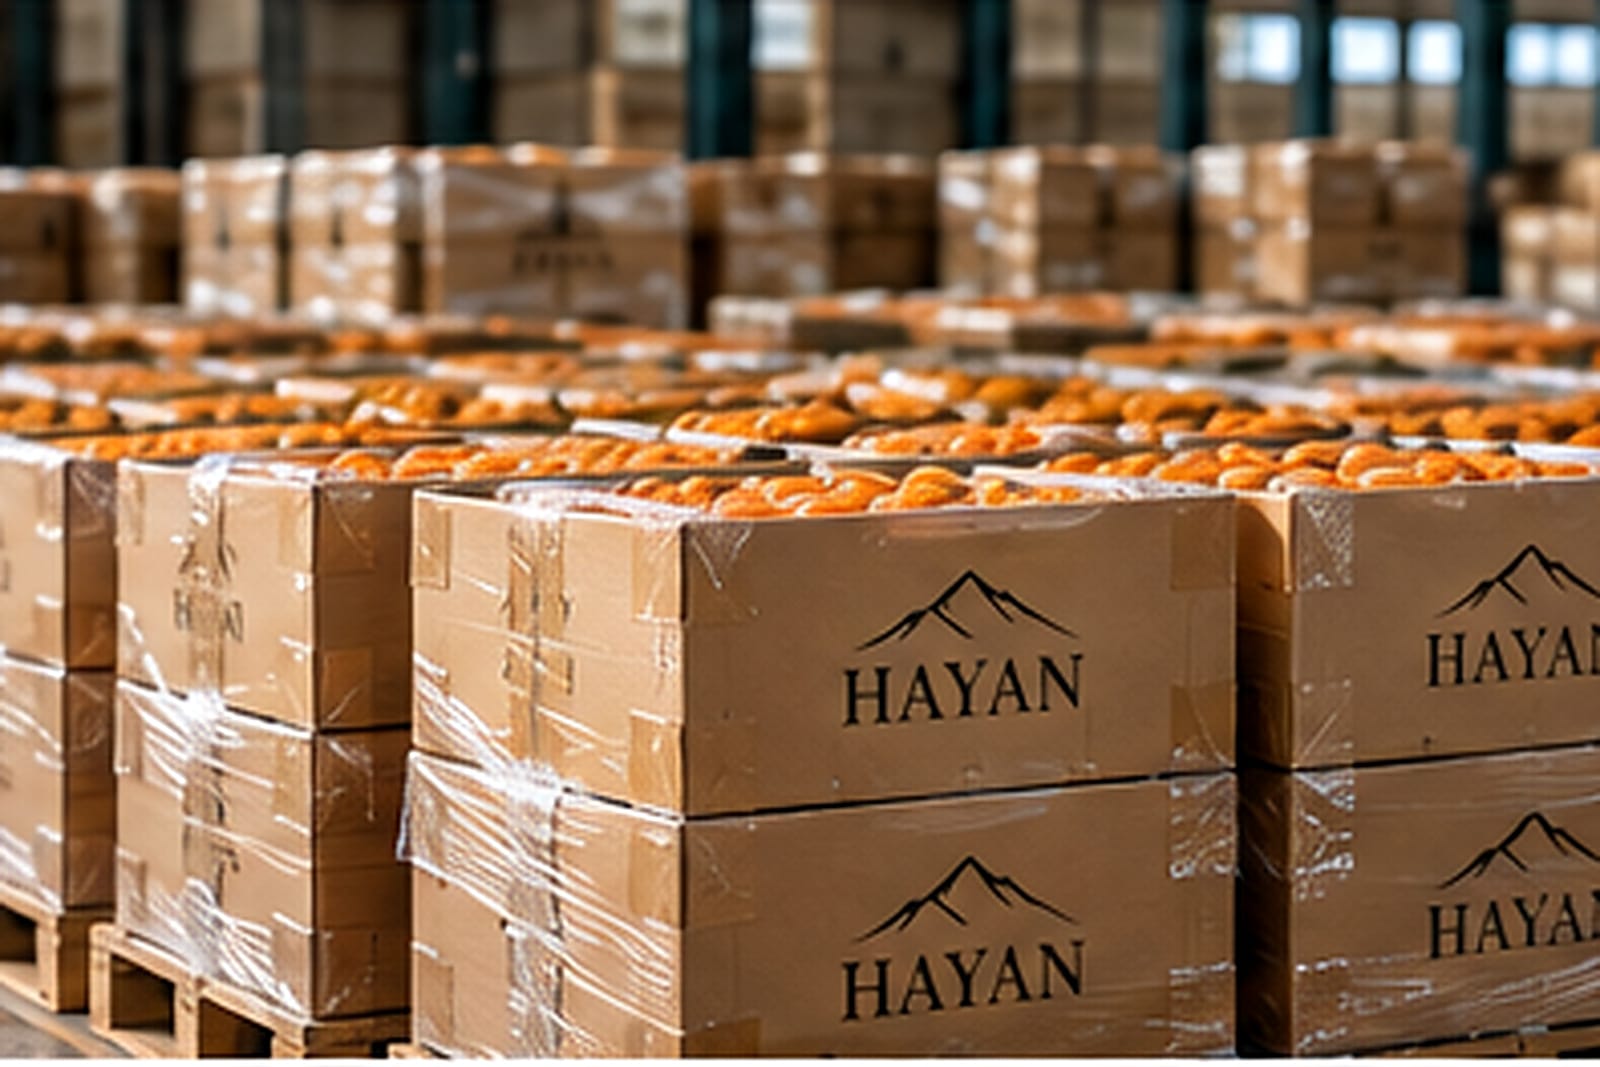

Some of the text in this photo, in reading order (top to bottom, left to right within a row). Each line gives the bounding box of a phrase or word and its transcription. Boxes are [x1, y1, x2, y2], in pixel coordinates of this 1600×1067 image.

[842, 654, 1084, 727] HAYAN
[1427, 623, 1600, 688] HAYA
[1428, 890, 1600, 960] HAYA
[841, 940, 1085, 1022] HAYAN
